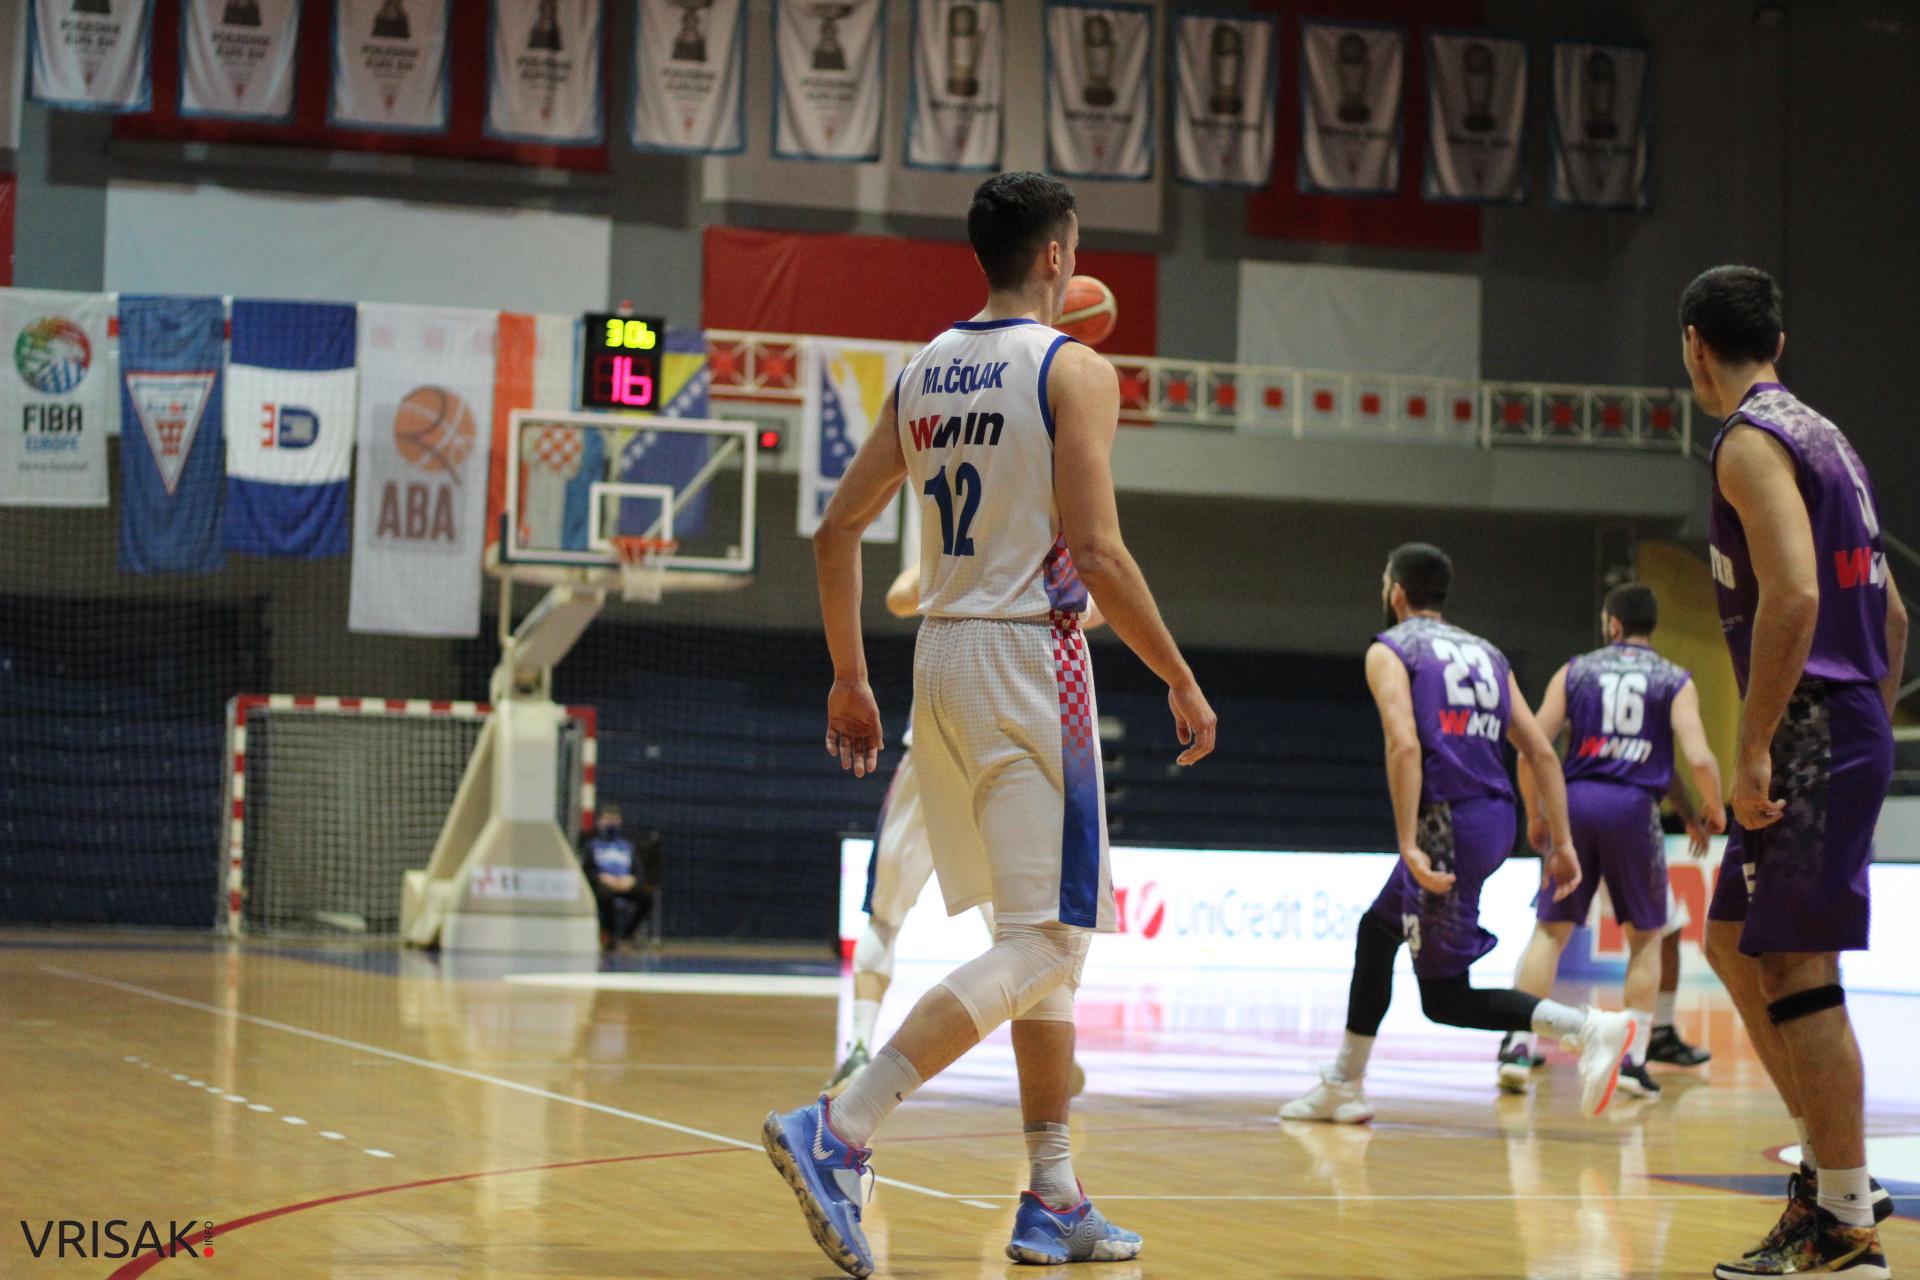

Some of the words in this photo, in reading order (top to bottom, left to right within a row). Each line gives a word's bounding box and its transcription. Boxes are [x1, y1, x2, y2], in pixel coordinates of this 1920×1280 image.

[612, 355, 653, 406] 16
[922, 357, 1009, 396] M.ČOLAK
[23, 403, 83, 433] FIBA
[376, 481, 455, 542] ABA
[923, 462, 982, 557] 12
[1432, 637, 1500, 710] 23
[1599, 672, 1648, 736] 16
[1176, 888, 1302, 939] UniCredit
